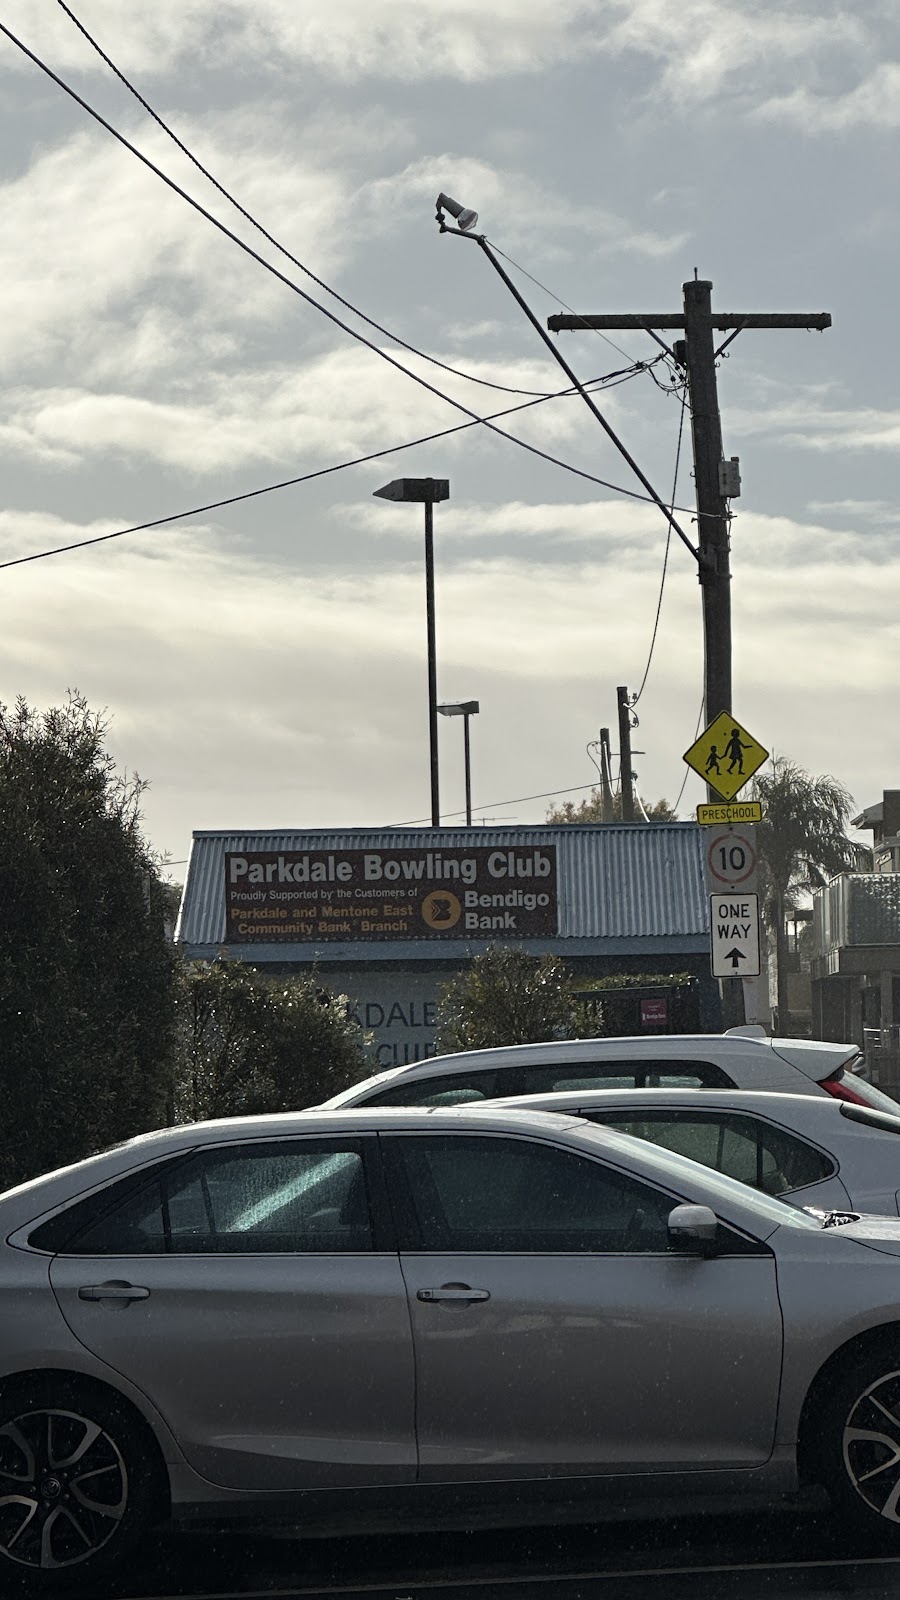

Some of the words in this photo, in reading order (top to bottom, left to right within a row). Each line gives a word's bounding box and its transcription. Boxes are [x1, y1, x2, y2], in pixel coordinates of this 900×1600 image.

[702, 807, 757, 820] PRESCHOOL
[720, 847, 745, 870] 10
[230, 856, 353, 883] Parkdale
[364, 853, 477, 884] Bowling
[488, 851, 551, 878] Club
[230, 891, 267, 902] Proudly
[269, 889, 318, 902] Supported
[320, 889, 333, 901] by
[337, 889, 352, 899] the
[354, 888, 405, 898] Customers
[407, 888, 418, 897] of
[465, 888, 549, 910] Bendigo
[231, 908, 286, 920] Parkdale
[292, 907, 316, 919] and
[322, 906, 378, 917] Mentone
[383, 904, 413, 916] East
[718, 903, 750, 919] ONE
[238, 922, 313, 935] Community
[318, 921, 351, 932] Bank
[361, 920, 407, 932] Branch
[465, 913, 516, 930] Bank
[717, 924, 751, 939] WAY
